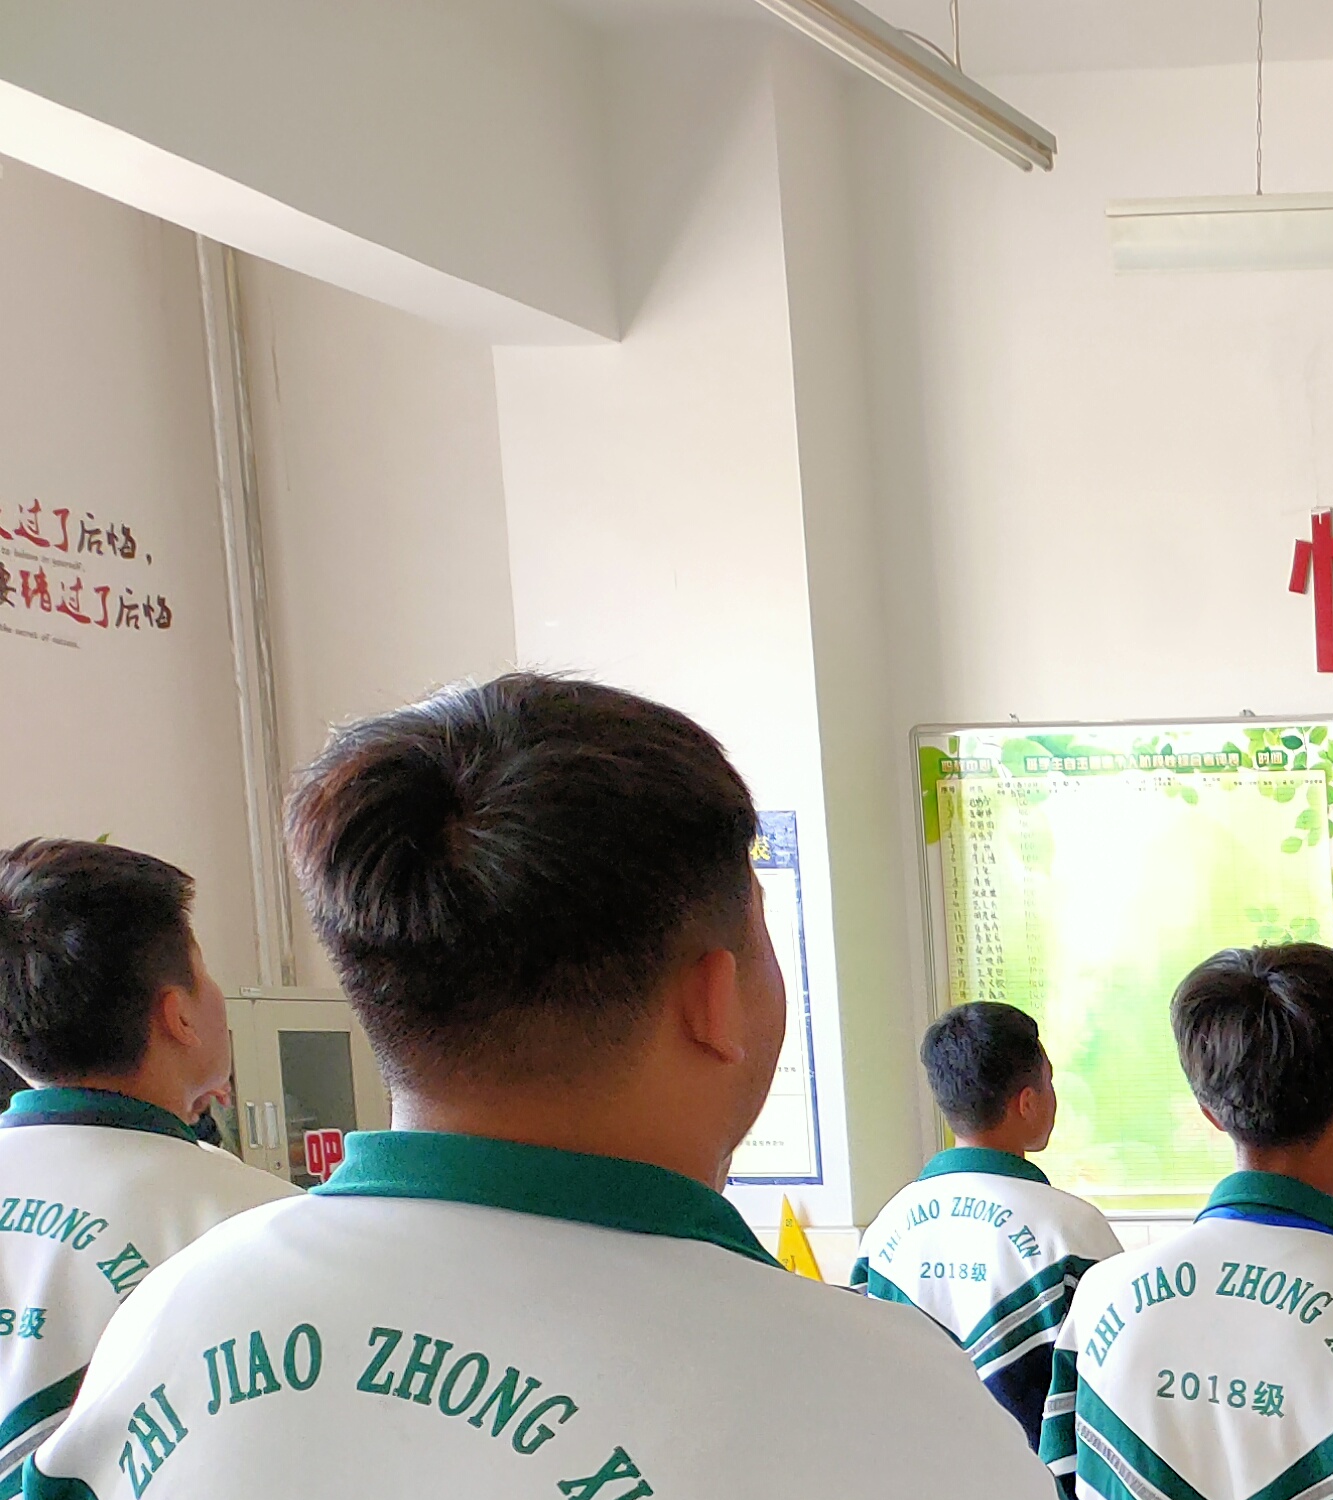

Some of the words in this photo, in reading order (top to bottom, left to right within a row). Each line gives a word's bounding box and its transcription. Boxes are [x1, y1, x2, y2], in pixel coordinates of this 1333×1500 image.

[0, 1197, 110, 1251] ZHONG
[950, 1196, 1014, 1228] ZHONG
[1007, 1225, 1043, 1260] XIN
[919, 1261, 988, 1283] 2018级
[1084, 1302, 1126, 1368] ZHI
[1130, 1261, 1197, 1314] JIAO
[1215, 1261, 1333, 1325] ZHONG
[118, 1382, 190, 1500] ZHI
[203, 1322, 323, 1415] JIAO
[356, 1326, 580, 1455] ZHONG
[1155, 1368, 1286, 1419] 2018级
